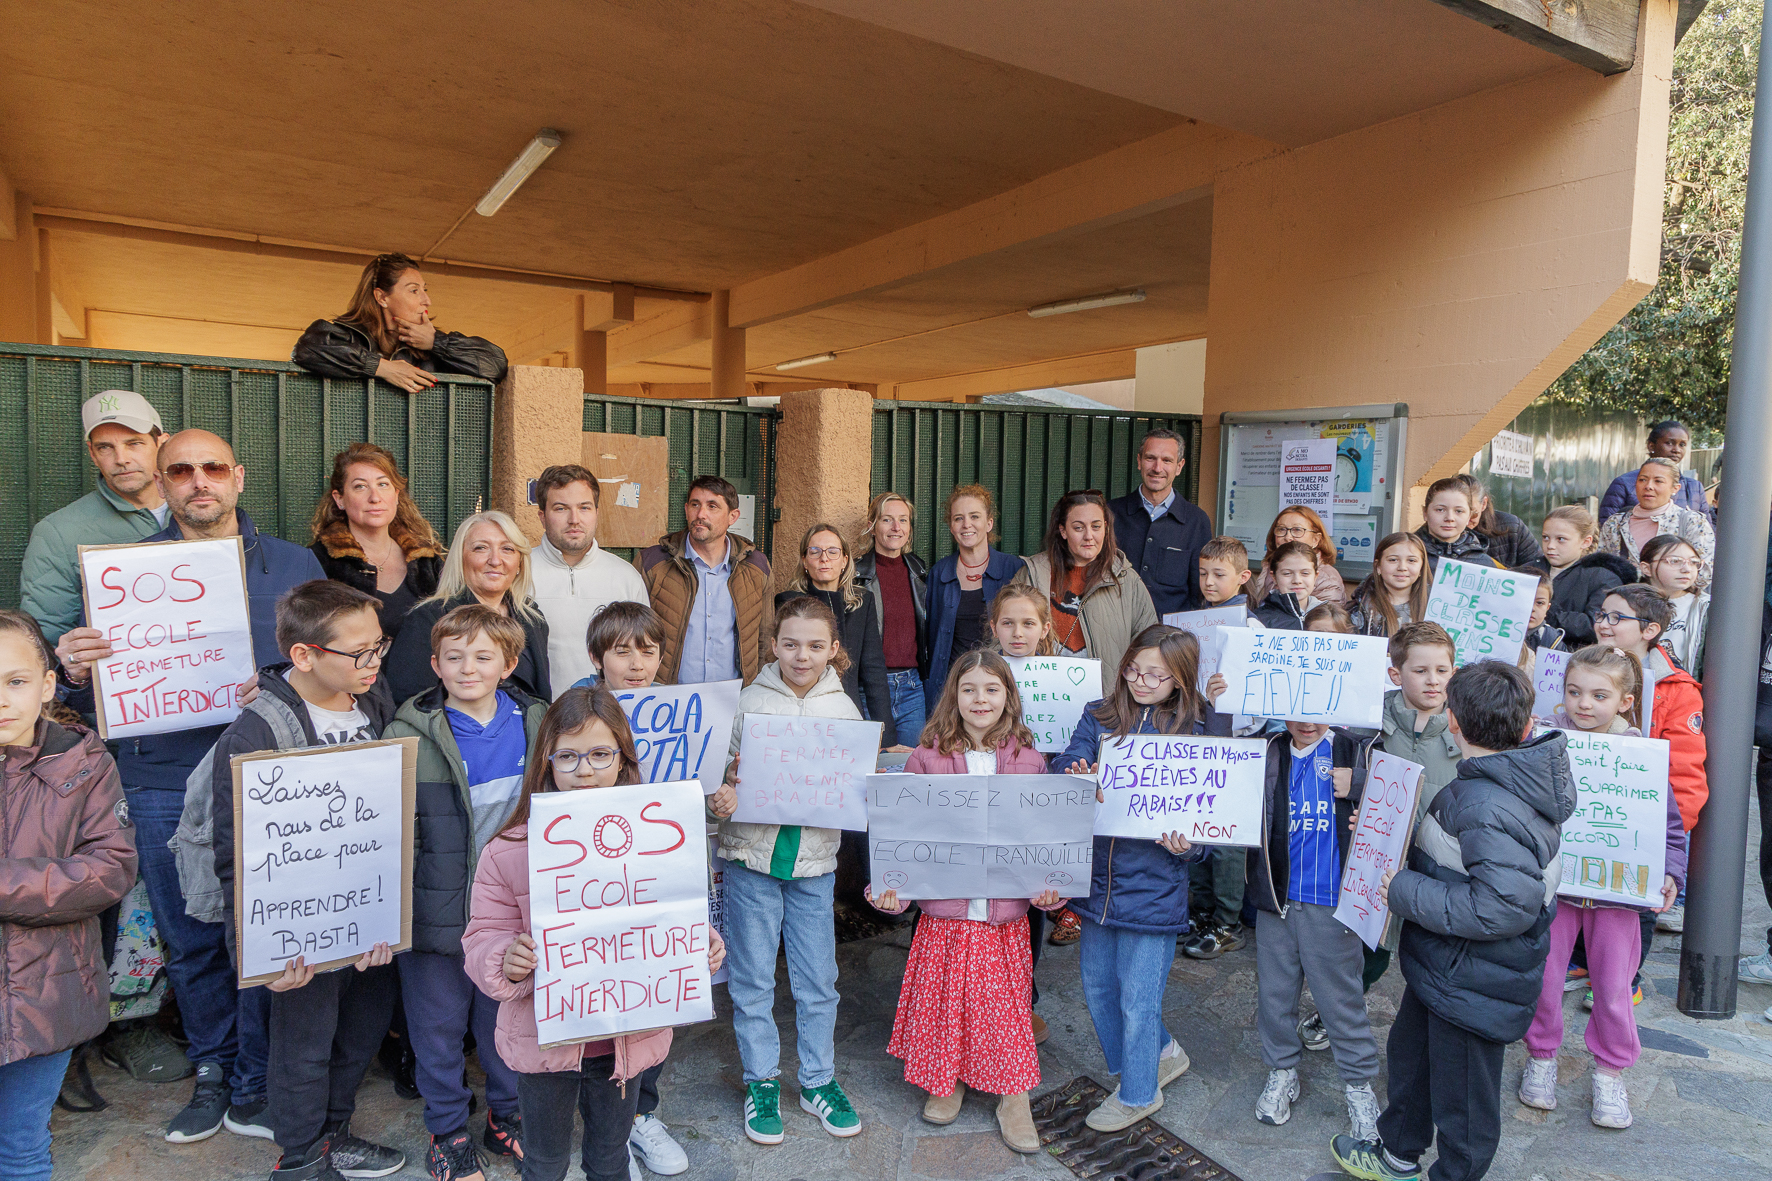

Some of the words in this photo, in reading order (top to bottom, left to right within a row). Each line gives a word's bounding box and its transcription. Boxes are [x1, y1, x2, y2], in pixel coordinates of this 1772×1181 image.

[1299, 483, 1320, 491] CLASSE
[1317, 475, 1329, 483] PAS
[98, 564, 206, 610] SOS
[109, 620, 207, 655] ECOLE
[1268, 636, 1286, 651] NE
[1313, 637, 1333, 652] PAS
[1337, 639, 1359, 652] UNE
[107, 648, 225, 682] FERMETURE
[1298, 655, 1309, 669] JE
[1338, 661, 1352, 673] UN
[750, 721, 836, 739] CLASSE
[1117, 738, 1135, 760] 1
[1140, 742, 1200, 760] CLASSE
[1202, 745, 1218, 760] EN
[248, 765, 347, 813] Laissez
[774, 771, 854, 788] AVENIR
[1102, 763, 1139, 790] DES
[1140, 763, 1198, 788] ÉLÈVES
[1202, 768, 1227, 789] AU
[1577, 776, 1659, 803] SUPPRIMER
[875, 783, 1001, 808] LAISSEZ
[1020, 789, 1094, 808] NOTRE
[320, 811, 346, 831] de
[355, 796, 380, 823] la
[1588, 801, 1628, 822] PAS
[537, 801, 685, 873] SOS
[1192, 821, 1237, 839] NON
[251, 842, 329, 882] place
[333, 839, 382, 870] pour
[873, 840, 966, 866] ECOLE
[976, 843, 1093, 866] TRANQUILLE
[271, 921, 359, 961] BASTA
[543, 922, 705, 972] FERMETURE
